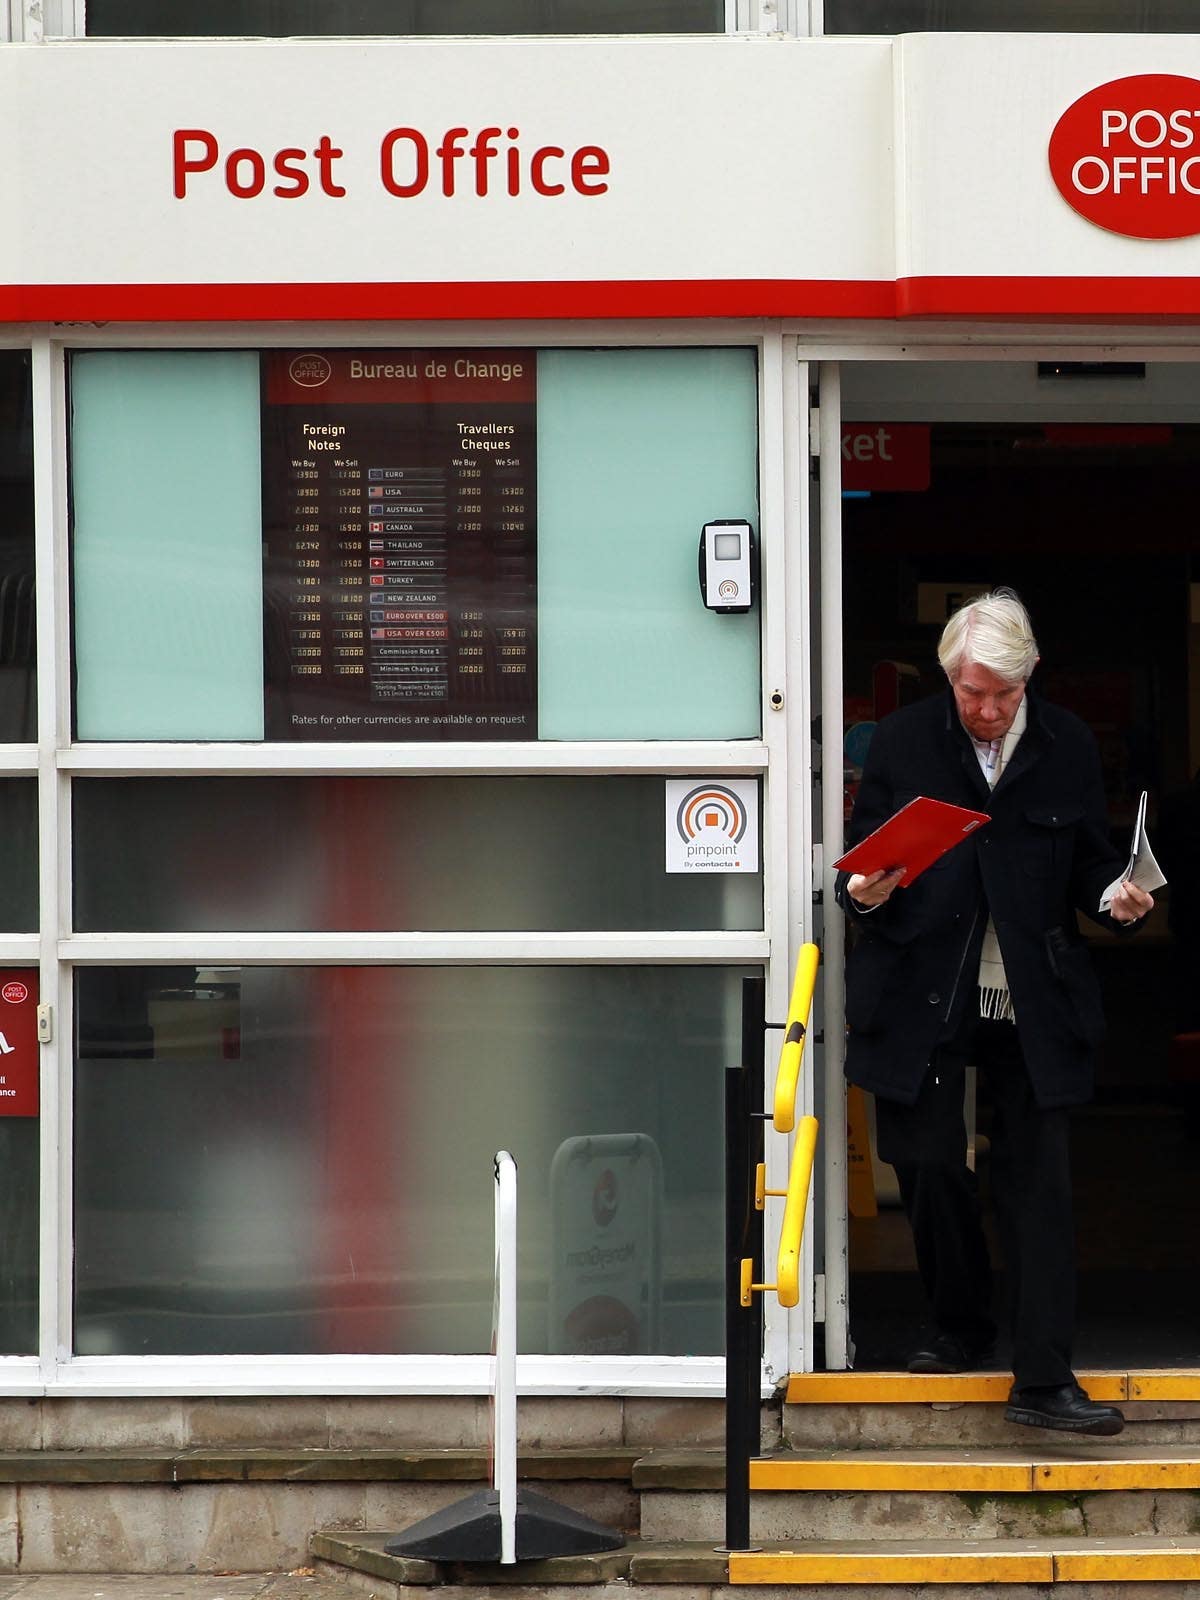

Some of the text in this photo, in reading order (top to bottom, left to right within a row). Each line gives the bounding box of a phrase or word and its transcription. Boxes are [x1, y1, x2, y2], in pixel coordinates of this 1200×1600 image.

[173, 127, 610, 199] Post Office
[299, 361, 321, 370] POST
[350, 359, 523, 381] Bureau de Change
[294, 370, 325, 379] OFFICE
[303, 424, 346, 436] Foreign
[457, 423, 515, 434] Travellers
[308, 440, 341, 450] Notes
[461, 439, 511, 452] Cheques
[303, 460, 316, 468] Buy
[464, 459, 477, 467] Buy
[385, 488, 402, 496] USA
[292, 715, 317, 724] Rates
[321, 715, 333, 724] for
[337, 715, 361, 724] other
[364, 715, 412, 724] currencies
[432, 715, 473, 724] available
[491, 716, 526, 726] request
[687, 844, 737, 857] pinpoint
